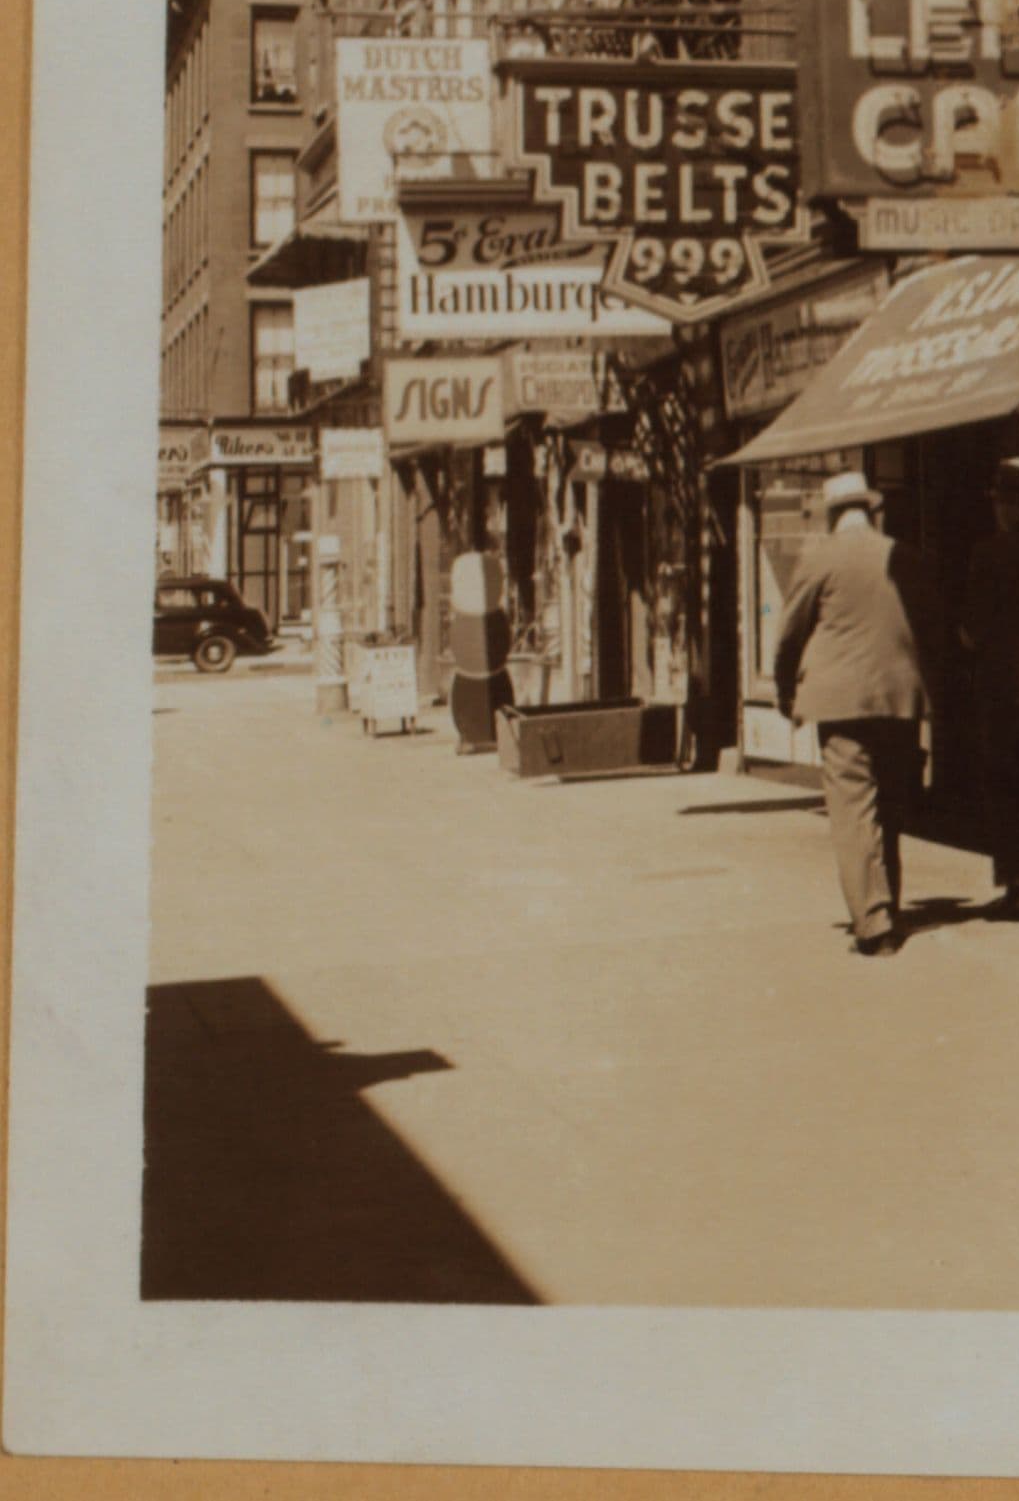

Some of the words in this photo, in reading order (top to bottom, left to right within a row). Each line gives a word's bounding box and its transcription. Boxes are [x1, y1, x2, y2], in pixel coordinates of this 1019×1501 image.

[362, 44, 465, 72] DUTCH
[342, 75, 486, 102] MASTERS
[584, 163, 792, 224] BELTS
[631, 238, 745, 284] 999
[394, 376, 494, 421] SIGNS
